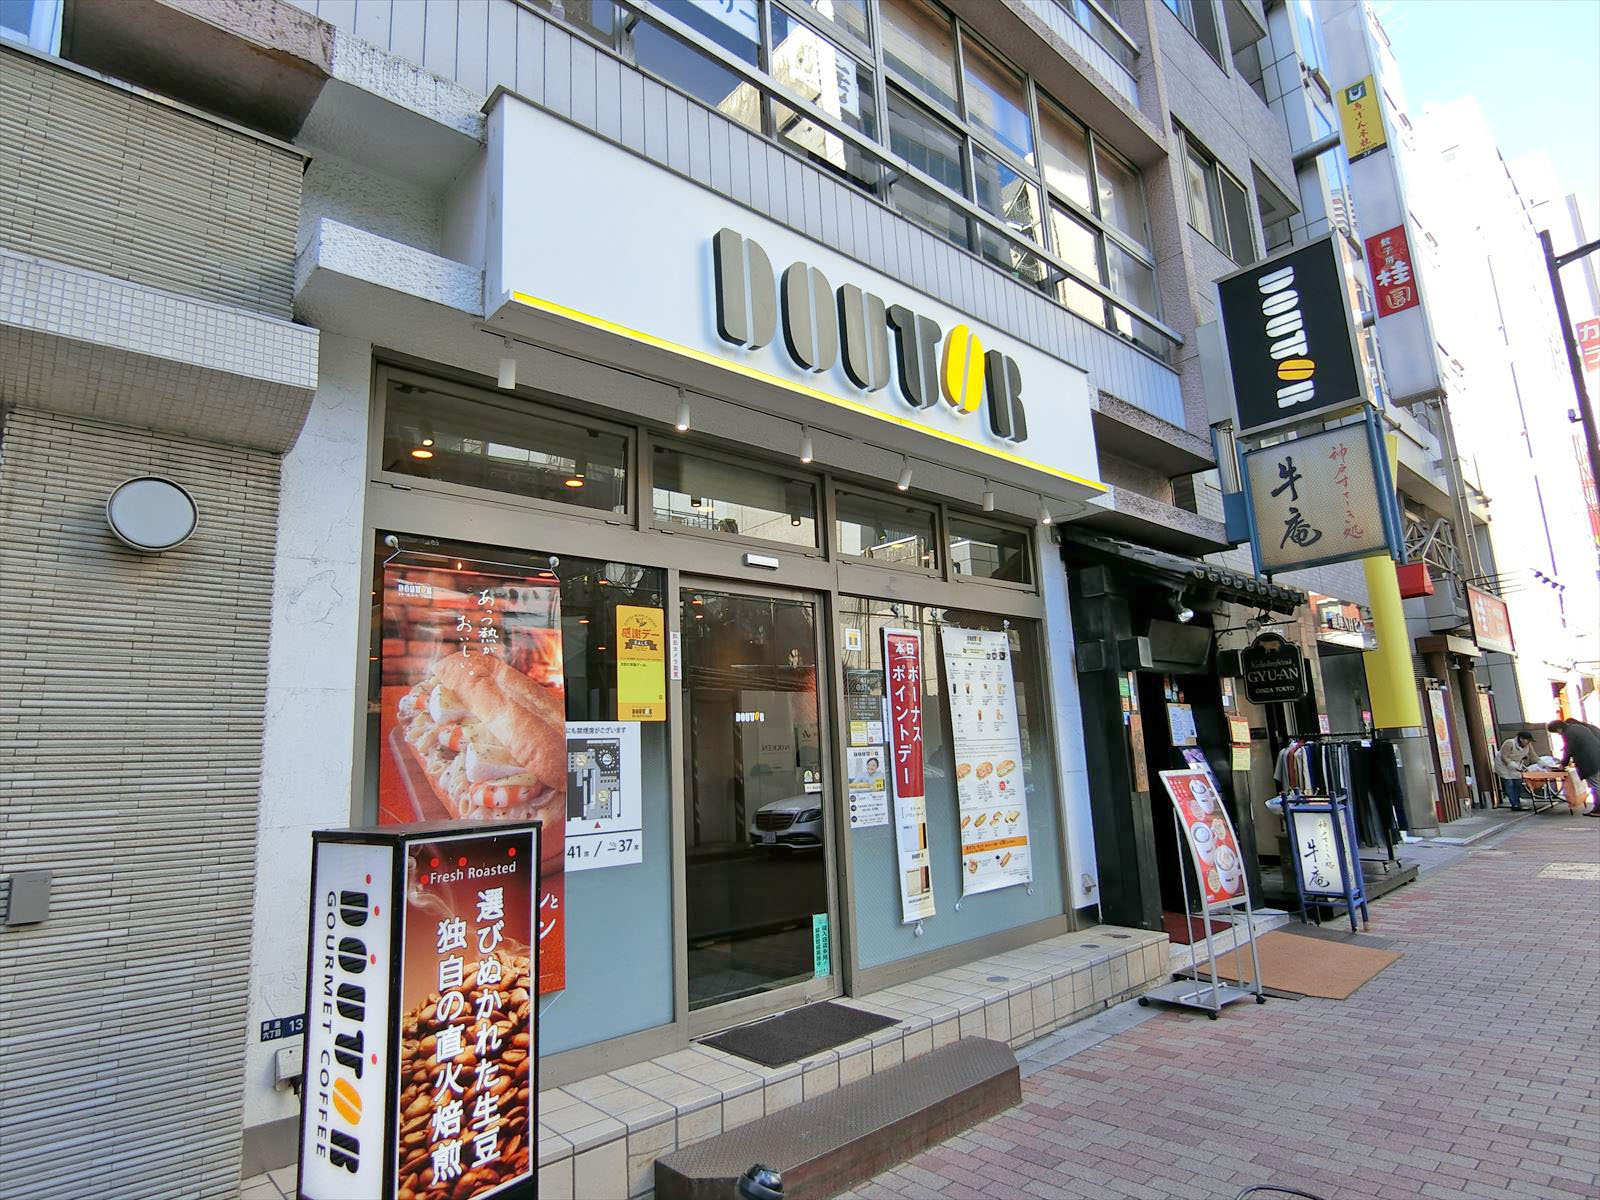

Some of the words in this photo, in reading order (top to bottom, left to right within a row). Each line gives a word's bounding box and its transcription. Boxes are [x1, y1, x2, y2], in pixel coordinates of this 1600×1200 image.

[713, 227, 1028, 443] DOUTOR
[1258, 265, 1315, 409] DOUTOR
[1271, 456, 1322, 550] 牛庵
[622, 626, 660, 640] 感謝デー
[895, 641, 914, 656] 本日
[735, 712, 765, 722] DOUTOR
[892, 664, 913, 785] ポイントデー
[907, 667, 922, 742] ボーナス
[430, 868, 464, 885] Fresh
[467, 861, 517, 879] Roasted
[1304, 838, 1330, 888] 牛庵
[322, 890, 337, 1035] GOURMET
[289, 1018, 304, 1032] 13
[330, 889, 369, 1174] DOUTOR
[431, 916, 468, 1187] 独自の直火焙煎
[471, 886, 505, 1170] 選びぬかれた生豆
[316, 1049, 332, 1160] COFFEE
